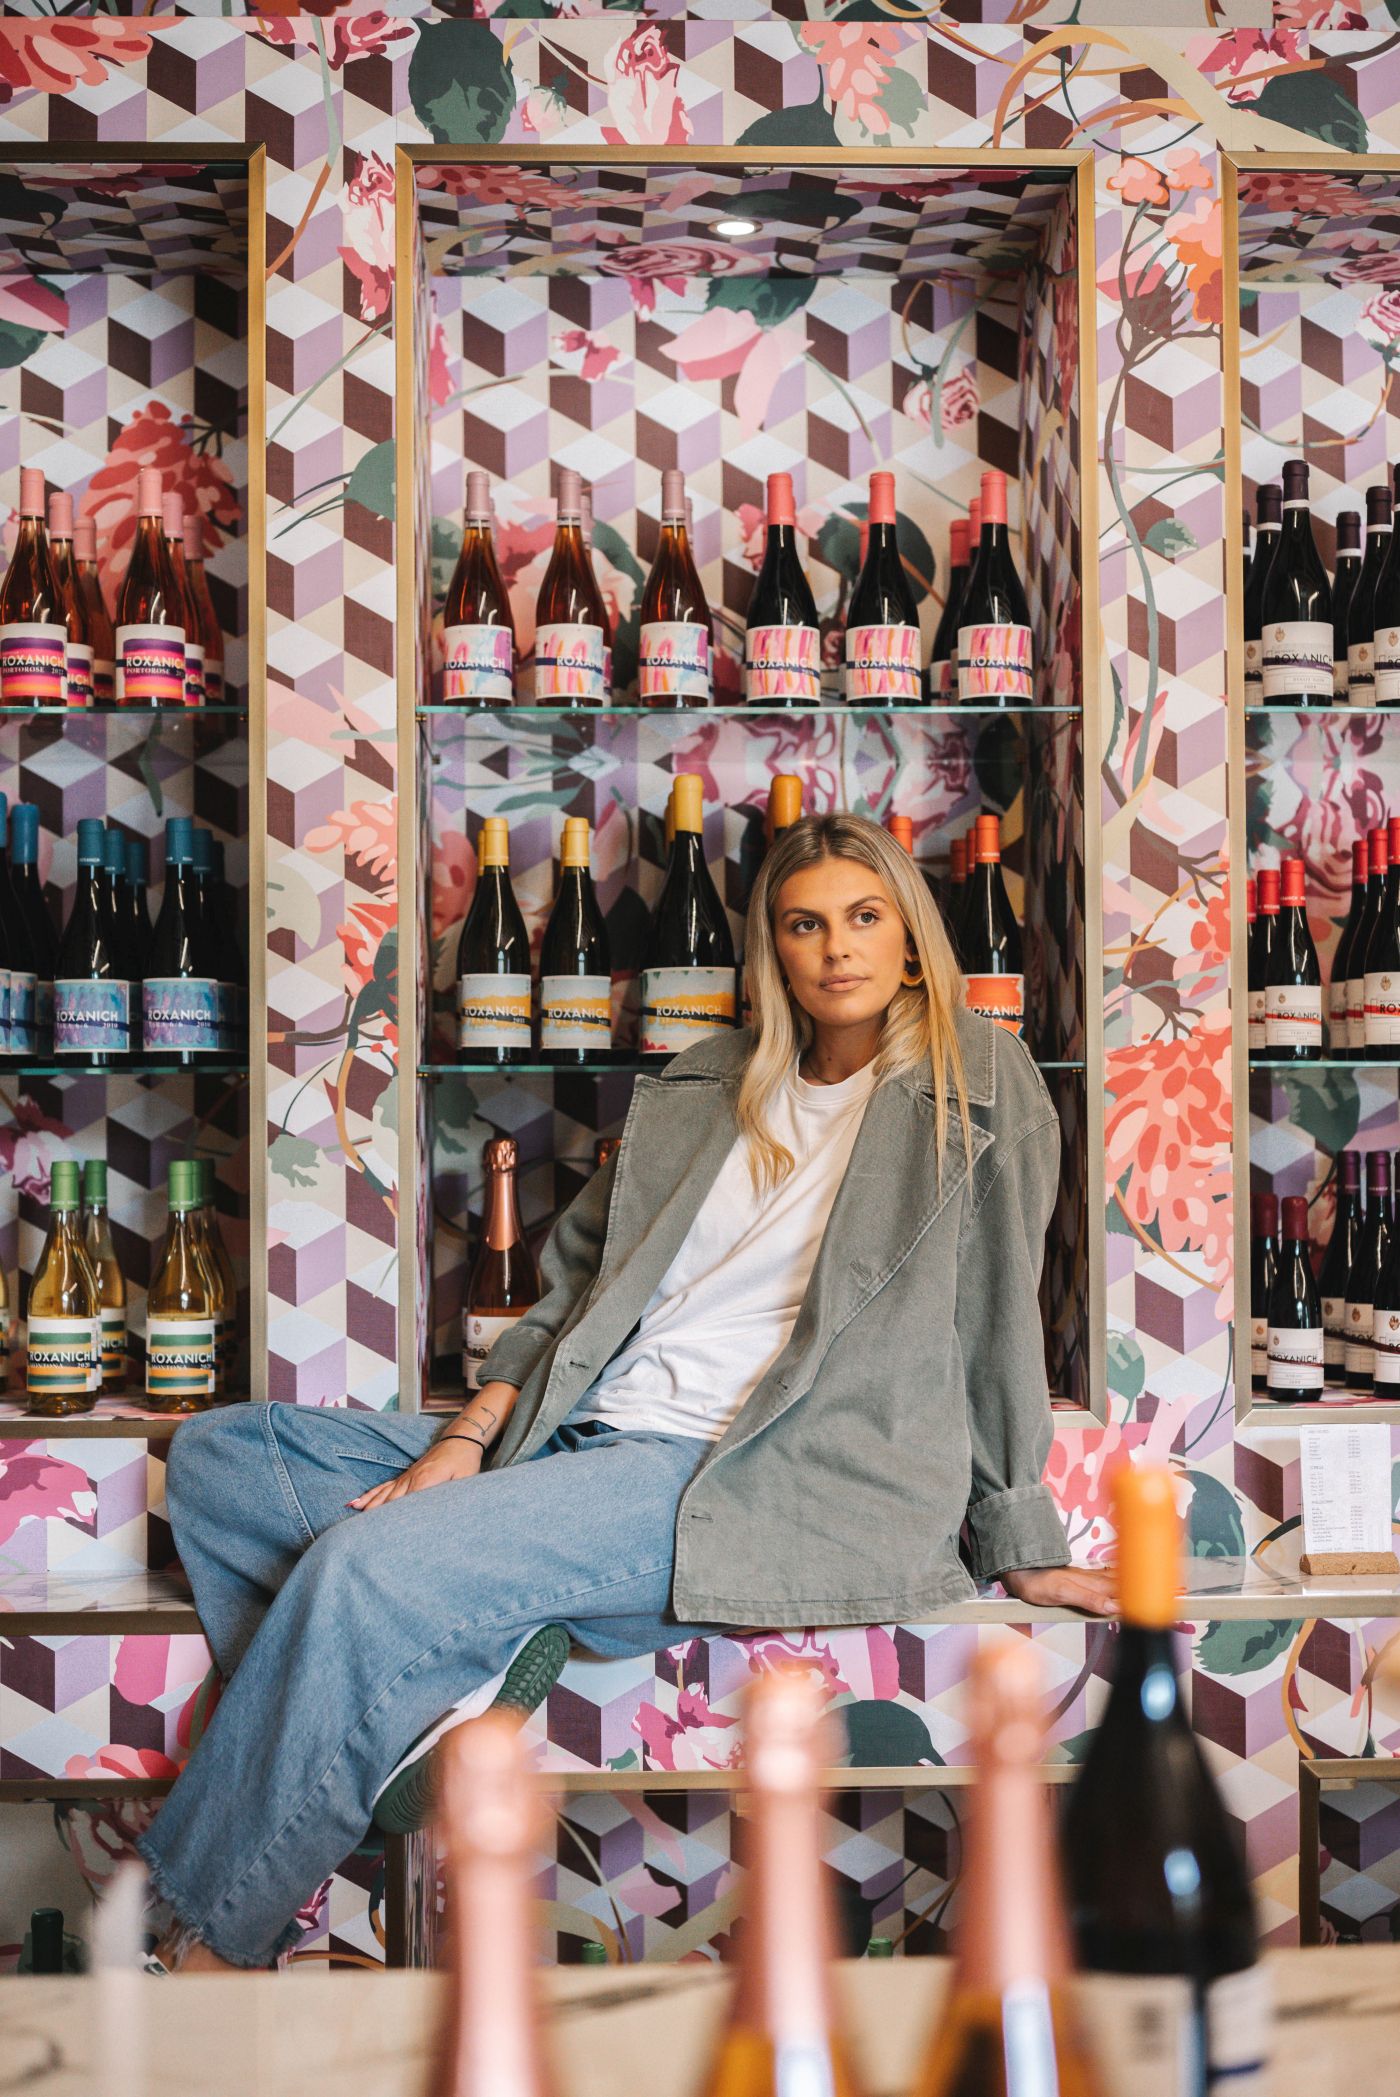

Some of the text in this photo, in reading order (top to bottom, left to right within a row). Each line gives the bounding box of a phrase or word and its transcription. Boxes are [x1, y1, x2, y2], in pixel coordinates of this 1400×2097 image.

[2, 653, 64, 668] ROXANICH
[3, 666, 45, 674] PORTOROSE
[56, 1010, 118, 1022] ROXANICH
[148, 1009, 211, 1021] ROXANICH
[464, 1005, 526, 1018] ROXANICH
[547, 1007, 609, 1019] ROXANICH
[656, 1005, 722, 1016] ROXANICH
[29, 1351, 92, 1363] ROXANICH
[151, 1352, 213, 1364] ROXANICH
